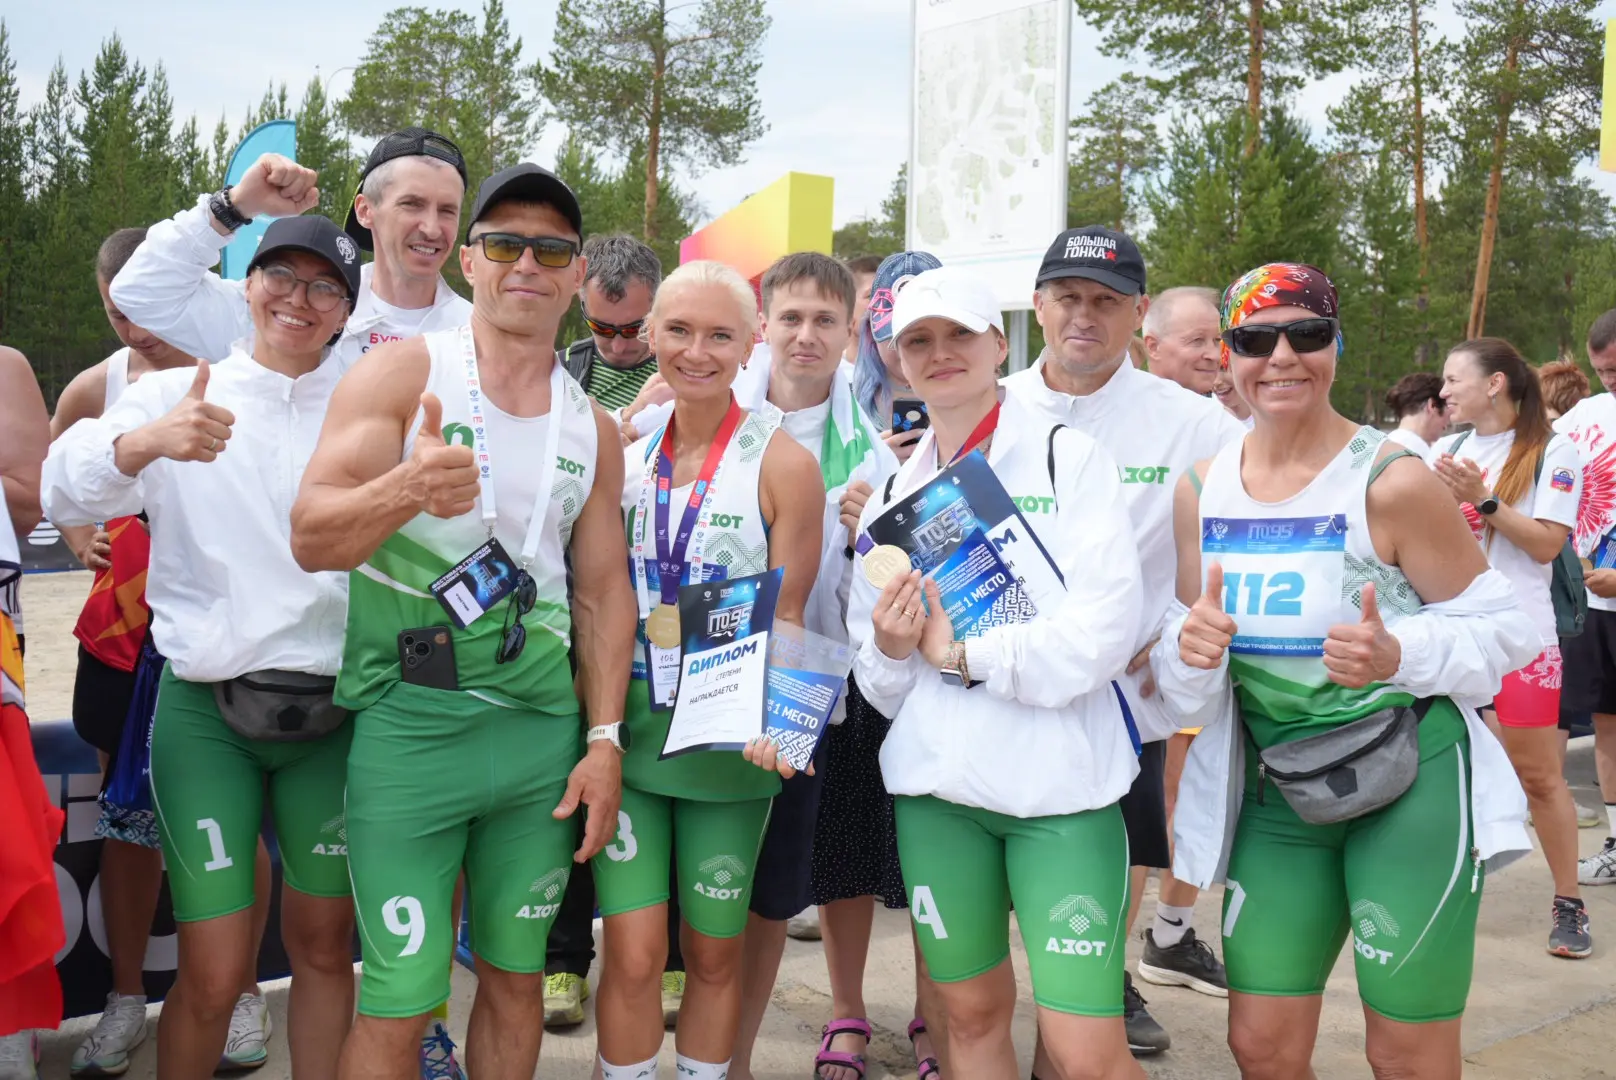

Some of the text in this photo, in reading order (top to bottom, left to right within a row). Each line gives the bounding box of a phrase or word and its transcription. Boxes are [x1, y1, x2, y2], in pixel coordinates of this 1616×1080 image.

[1064, 247, 1106, 260] ГОНКА
[1066, 236, 1116, 250] БОЛЬШАЯ
[557, 455, 586, 478] ЗОТ
[1117, 466, 1170, 484] ЗОТ
[1011, 496, 1054, 514] ЗОТ
[709, 513, 744, 529] ЗОТ
[964, 596, 974, 608] 1
[970, 572, 1007, 603] МЕСТО
[1223, 571, 1306, 616] 112
[687, 640, 758, 677] ДИПЛОМ
[715, 667, 742, 681] СТЕПЕНИ
[689, 683, 739, 706] НАГРАЖДАЕТСЯ
[772, 703, 781, 715] 1
[782, 706, 819, 730] МЕСТО
[197, 818, 233, 871] 1
[605, 810, 638, 862] 3
[693, 881, 743, 900] АЗОТ
[515, 902, 561, 919] АЗОТ
[381, 895, 426, 958] 9
[1045, 937, 1107, 956] АЗОТ
